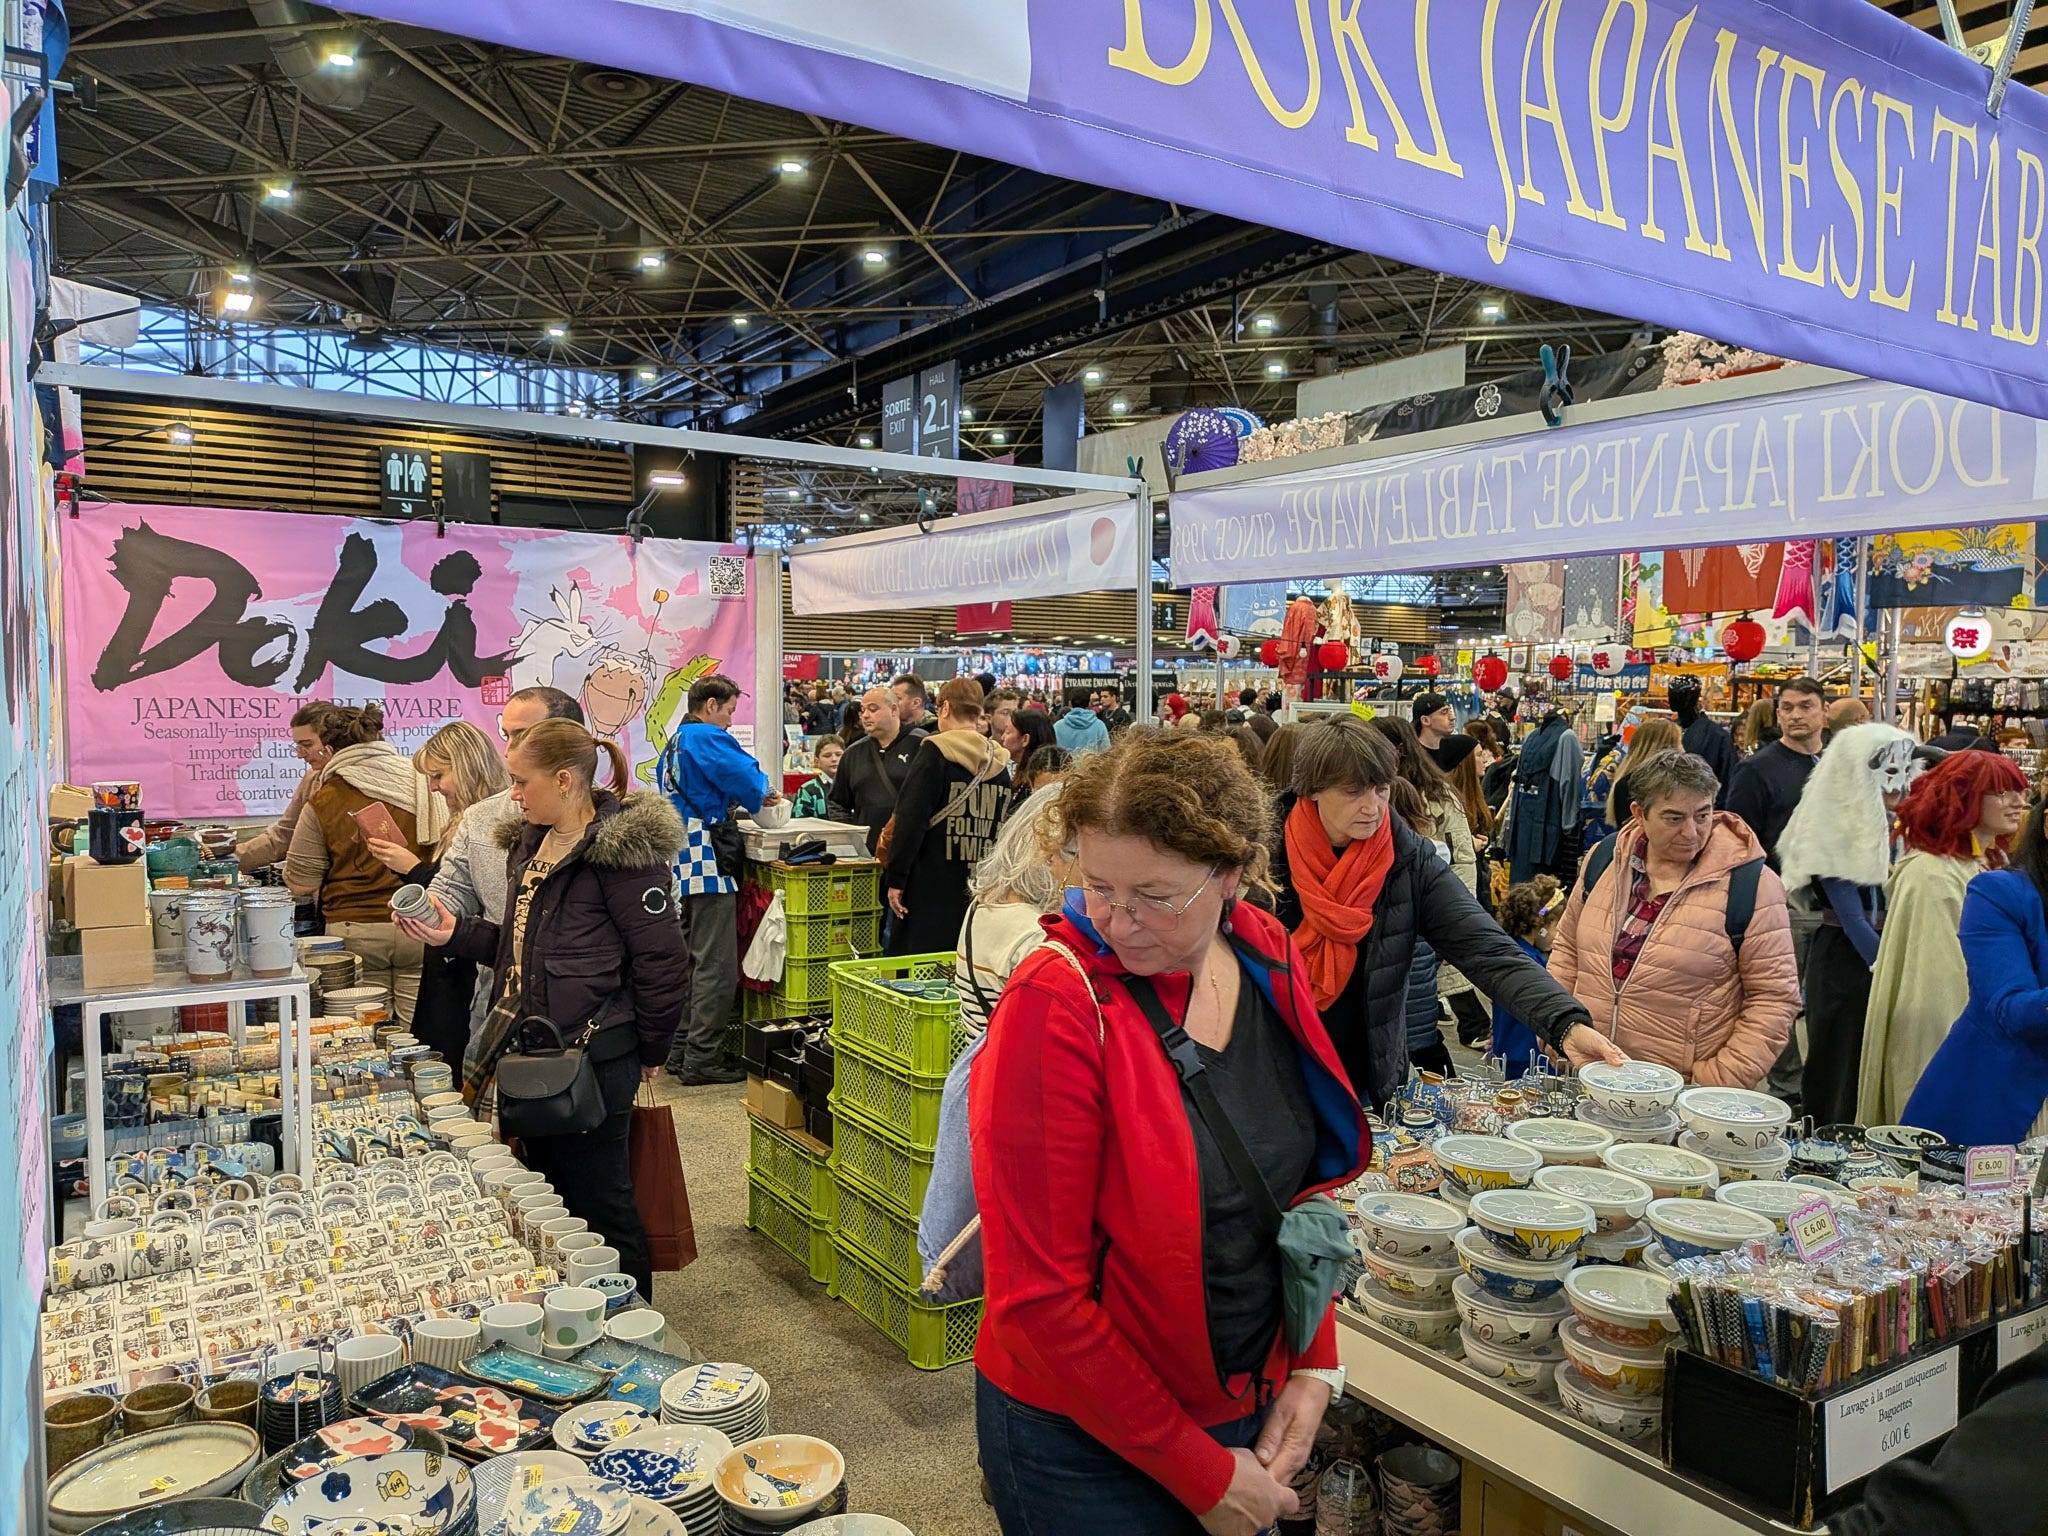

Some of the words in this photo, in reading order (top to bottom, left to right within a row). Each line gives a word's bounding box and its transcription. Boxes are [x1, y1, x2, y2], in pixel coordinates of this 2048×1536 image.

[1481, 0, 1916, 312] JAPANESE
[1930, 105, 2048, 346] TAB
[929, 372, 945, 387] HALL
[884, 397, 912, 418] SORTIE
[923, 394, 950, 435] 2.1
[889, 418, 906, 435] EXIT
[90, 516, 535, 693] Doki
[1164, 606, 1174, 621] 1
[1952, 627, 1979, 648] 祭
[1093, 677, 1118, 688] ENFANCE
[131, 697, 282, 725] JAPANESE
[189, 744, 262, 764] imported
[187, 764, 275, 781] Traditional
[279, 763, 307, 780] and
[216, 785, 294, 801] decorative
[1977, 1161, 1984, 1170] €
[1984, 1160, 2003, 1170] 6.00
[1803, 1226, 1810, 1237] €
[1810, 1218, 1827, 1234] 6.00
[2010, 1322, 2034, 1338] Lavage
[1840, 1398, 1869, 1418] Lavage
[1870, 1392, 1875, 1405] à
[1877, 1388, 1884, 1403] la
[1885, 1381, 1904, 1400] main
[1904, 1360, 1948, 1387] uniquement
[1878, 1397, 1913, 1423] Baguettes
[1881, 1428, 1901, 1451] 6.00
[1903, 1422, 1911, 1440] €
